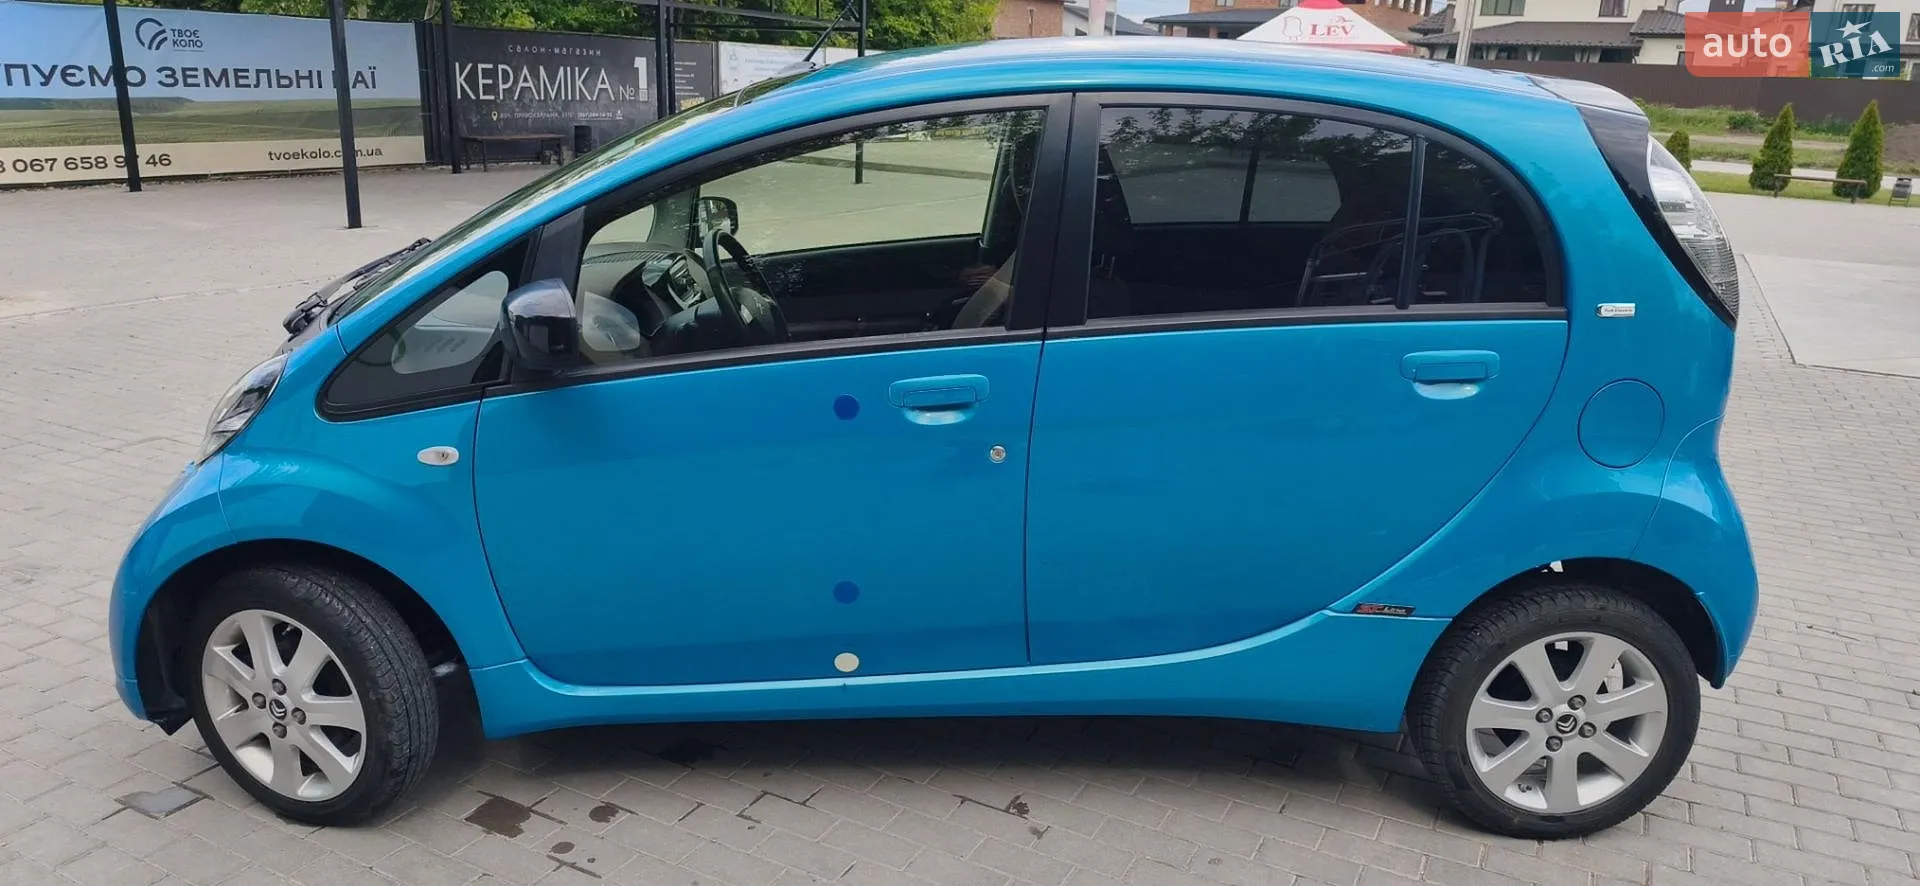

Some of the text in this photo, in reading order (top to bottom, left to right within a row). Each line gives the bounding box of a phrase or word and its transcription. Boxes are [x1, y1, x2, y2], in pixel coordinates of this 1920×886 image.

[170, 28, 200, 39] ТВОЄ
[1311, 23, 1355, 36] LEV
[172, 39, 203, 49] КОЛО
[0, 62, 377, 89] ПУЄМО ЗЕМЕЛЬНІ АЇ
[455, 62, 615, 101] КЕРАМІКА
[267, 147, 383, 161] tvoekolo.cm.ua
[12, 158, 58, 174] 067
[64, 155, 109, 171] 658
[145, 153, 172, 168] 46
